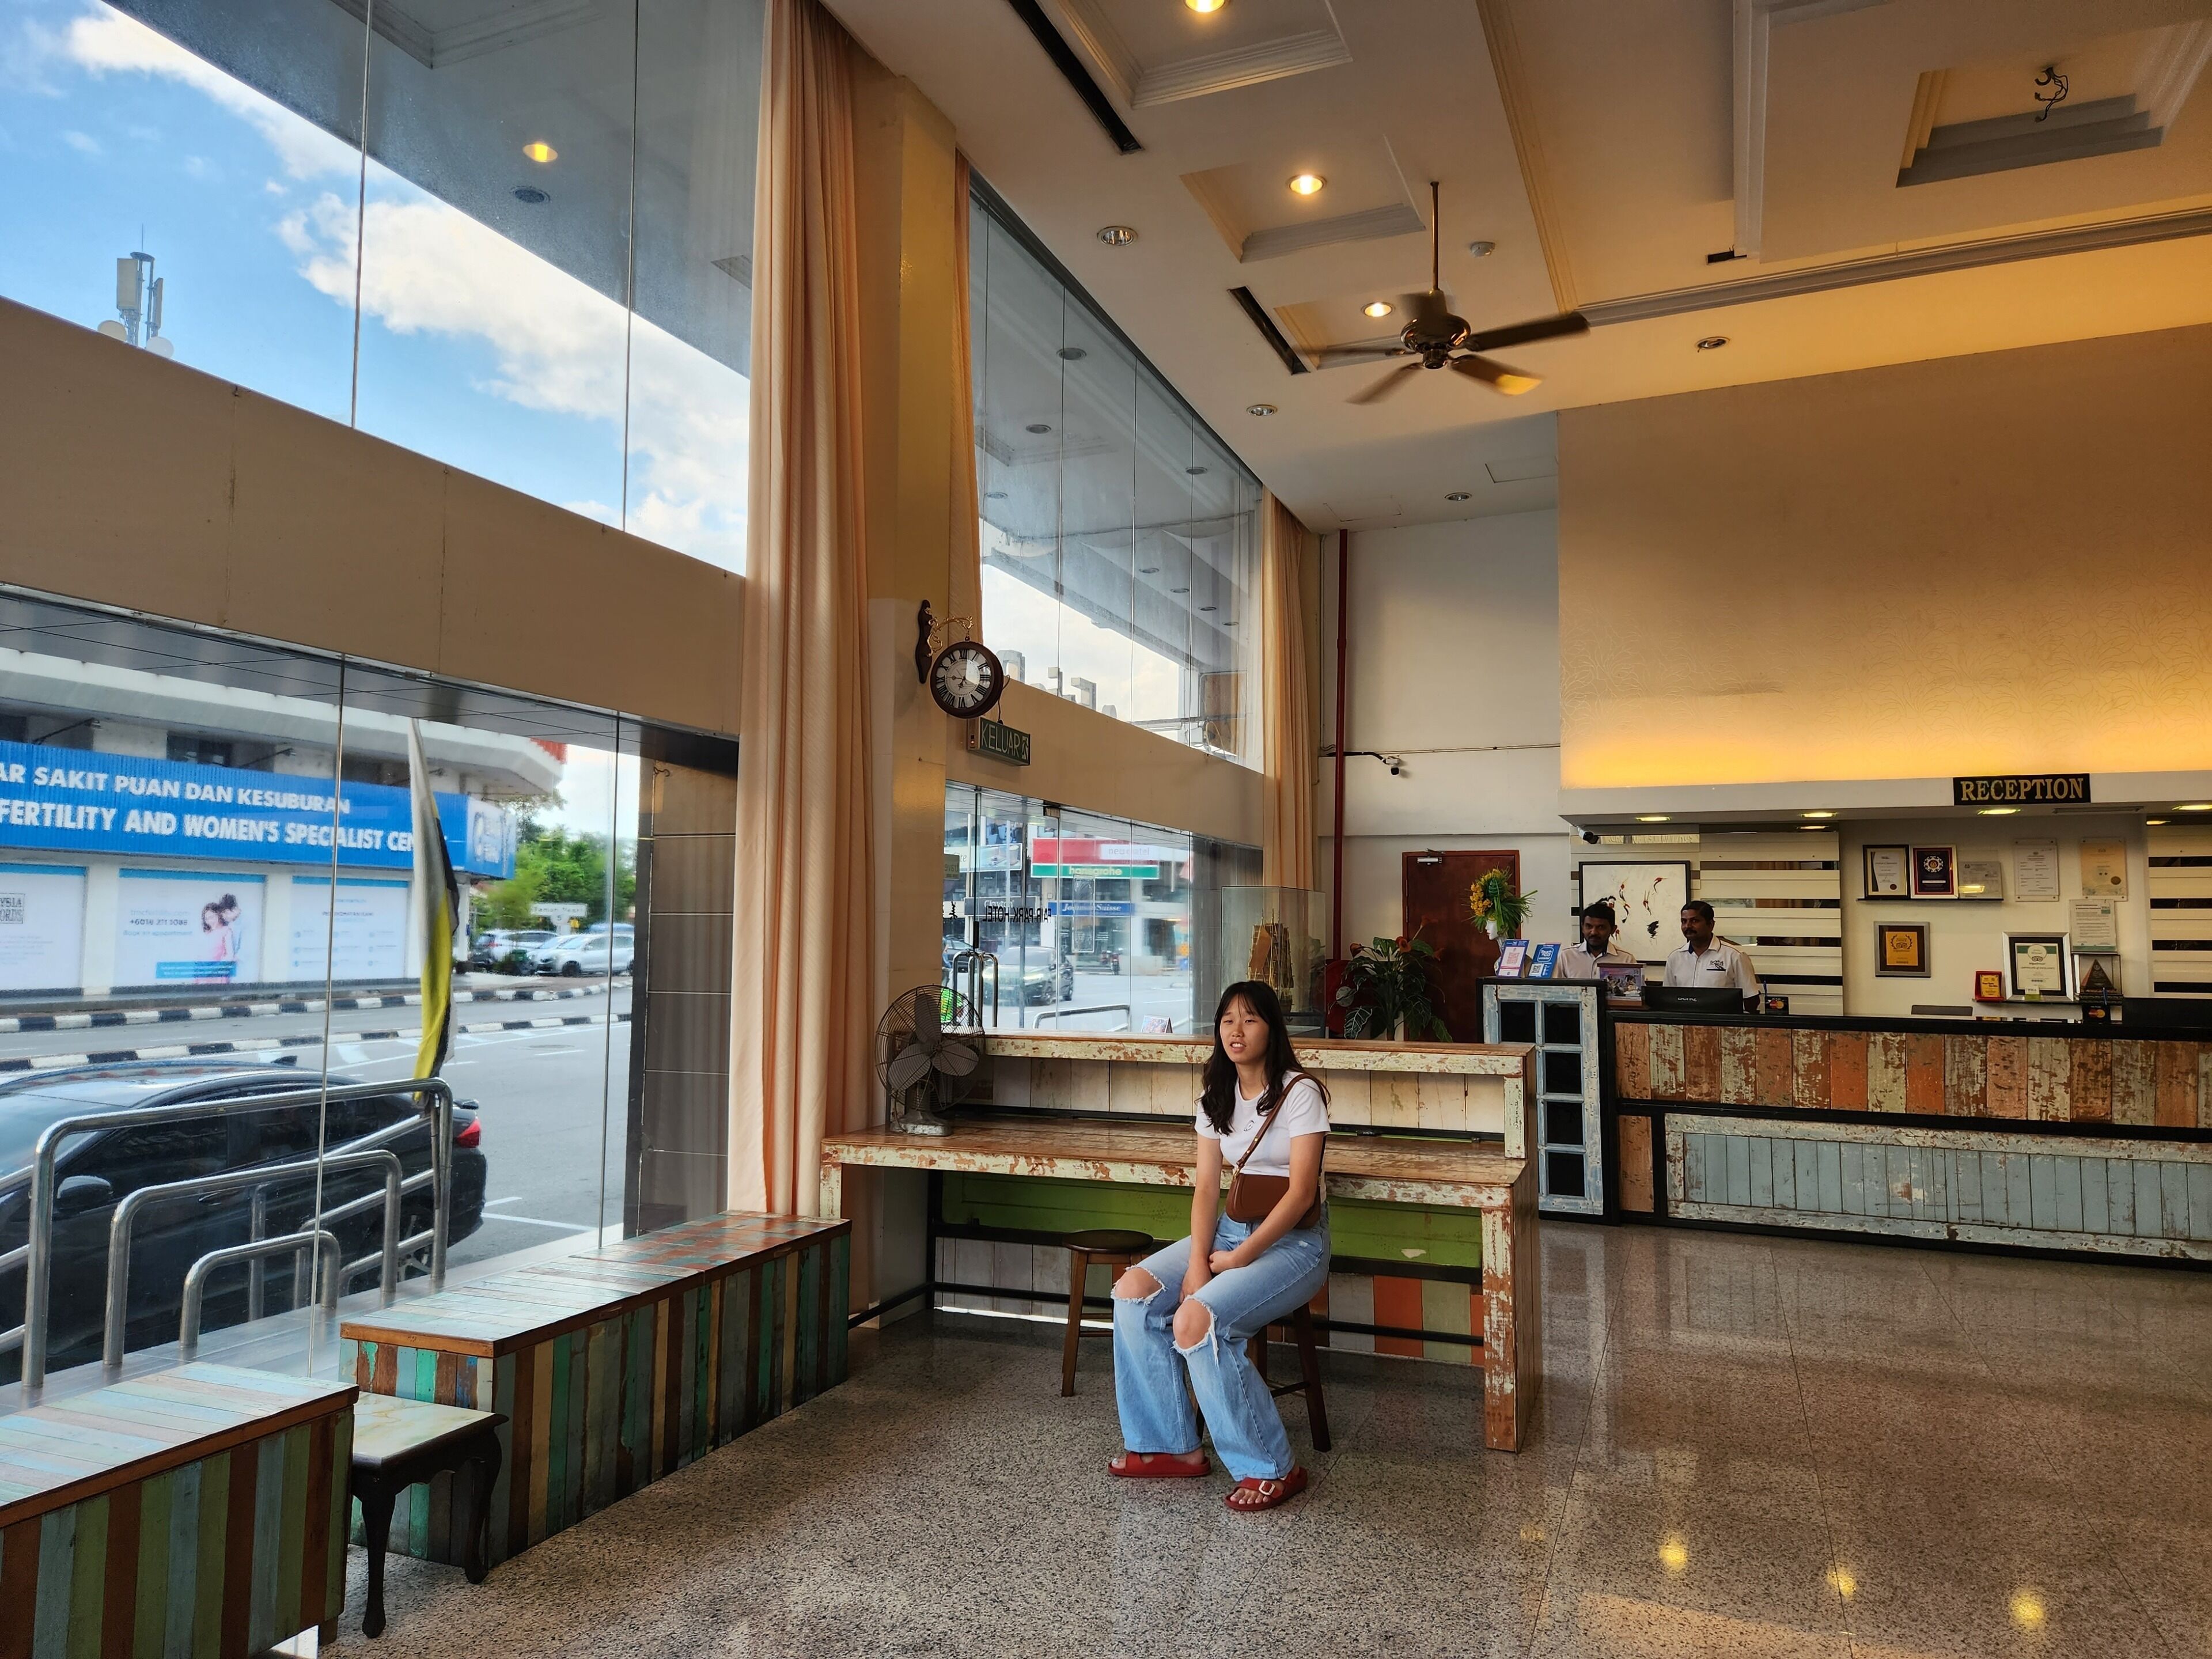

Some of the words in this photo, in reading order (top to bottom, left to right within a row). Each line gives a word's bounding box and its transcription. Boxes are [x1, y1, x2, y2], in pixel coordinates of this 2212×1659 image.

[981, 722, 1021, 758] KELUAR
[33, 767, 108, 791] SAKIT
[115, 775, 180, 798] PUAN
[185, 782, 233, 803] DAN
[237, 788, 350, 814] KESUBURAN
[1960, 778, 2084, 801] RECEPTION
[0, 798, 118, 831] FERTILITY
[124, 809, 177, 835] AND
[184, 813, 279, 843] WOMEN'S
[285, 821, 384, 850] SPECIALIST
[1096, 903, 1122, 911] Suisse
